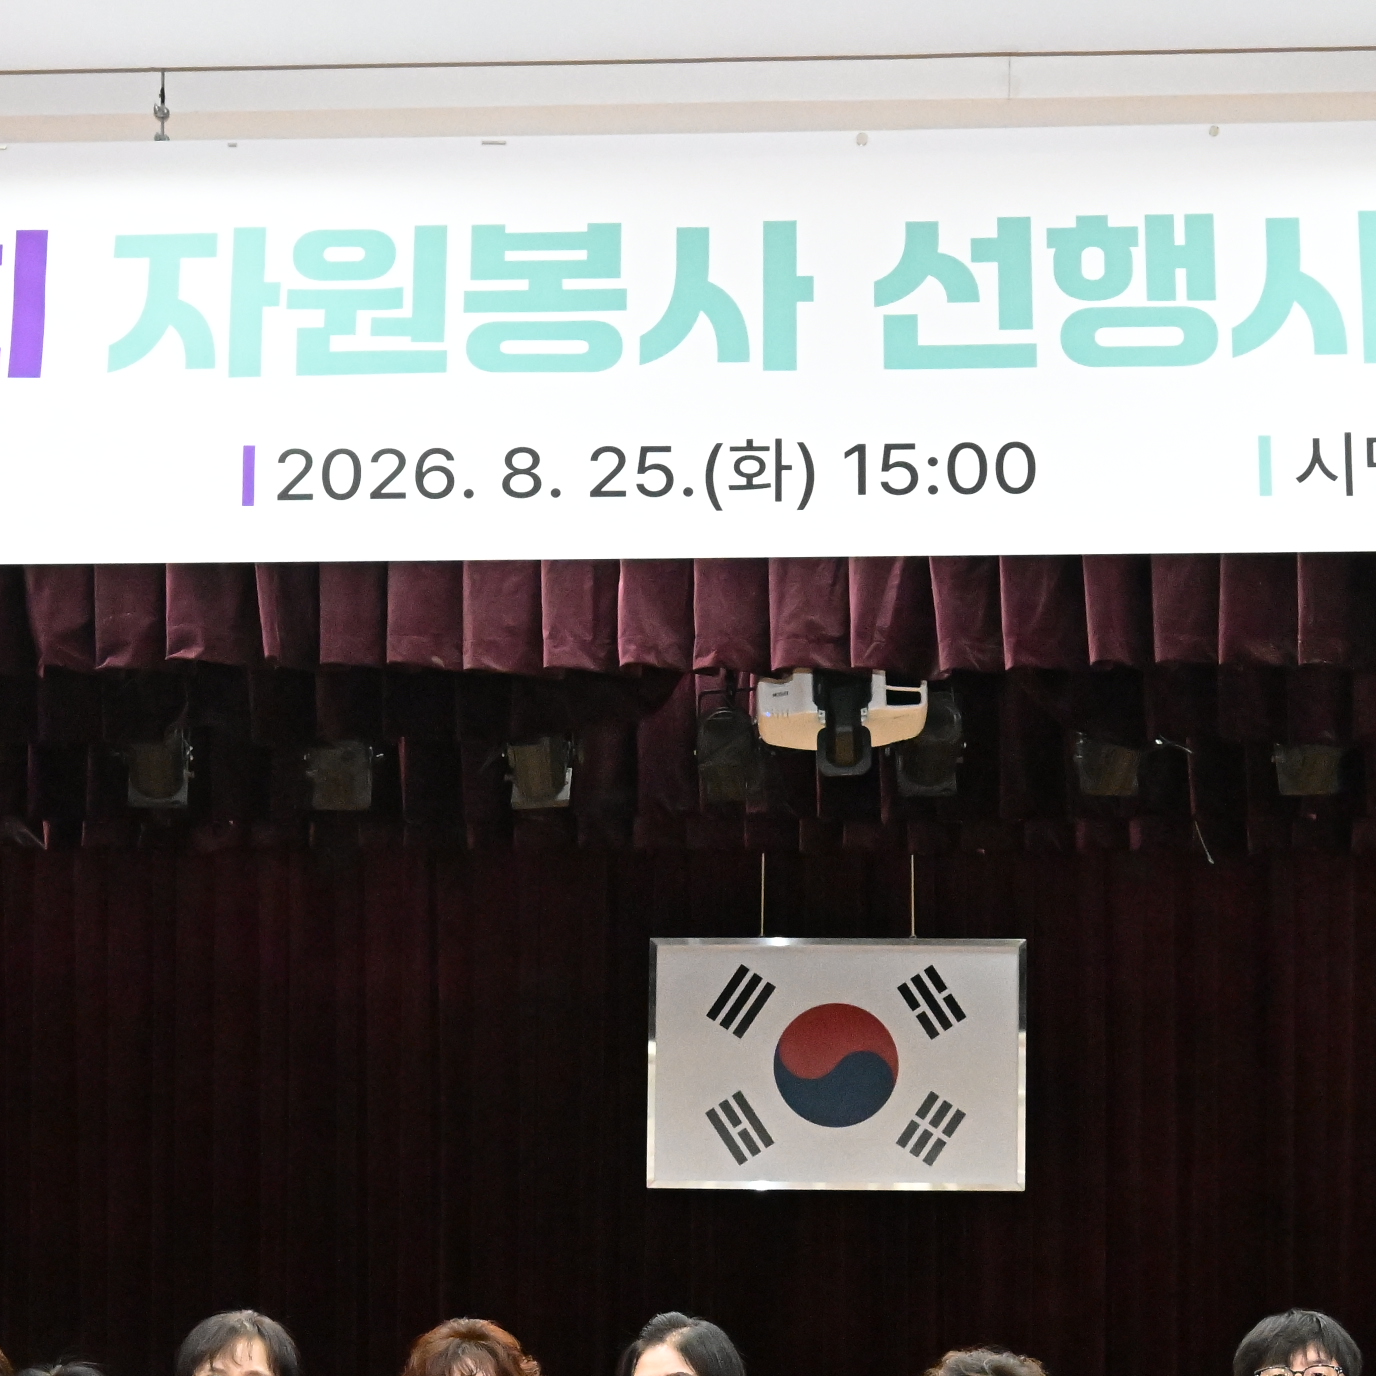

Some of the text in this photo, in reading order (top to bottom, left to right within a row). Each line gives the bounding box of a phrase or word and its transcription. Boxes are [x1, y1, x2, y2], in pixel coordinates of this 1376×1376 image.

[107, 219, 815, 378] 자원봉사
[277, 438, 1036, 512] 2026. 8. 25.(화) 15:00
